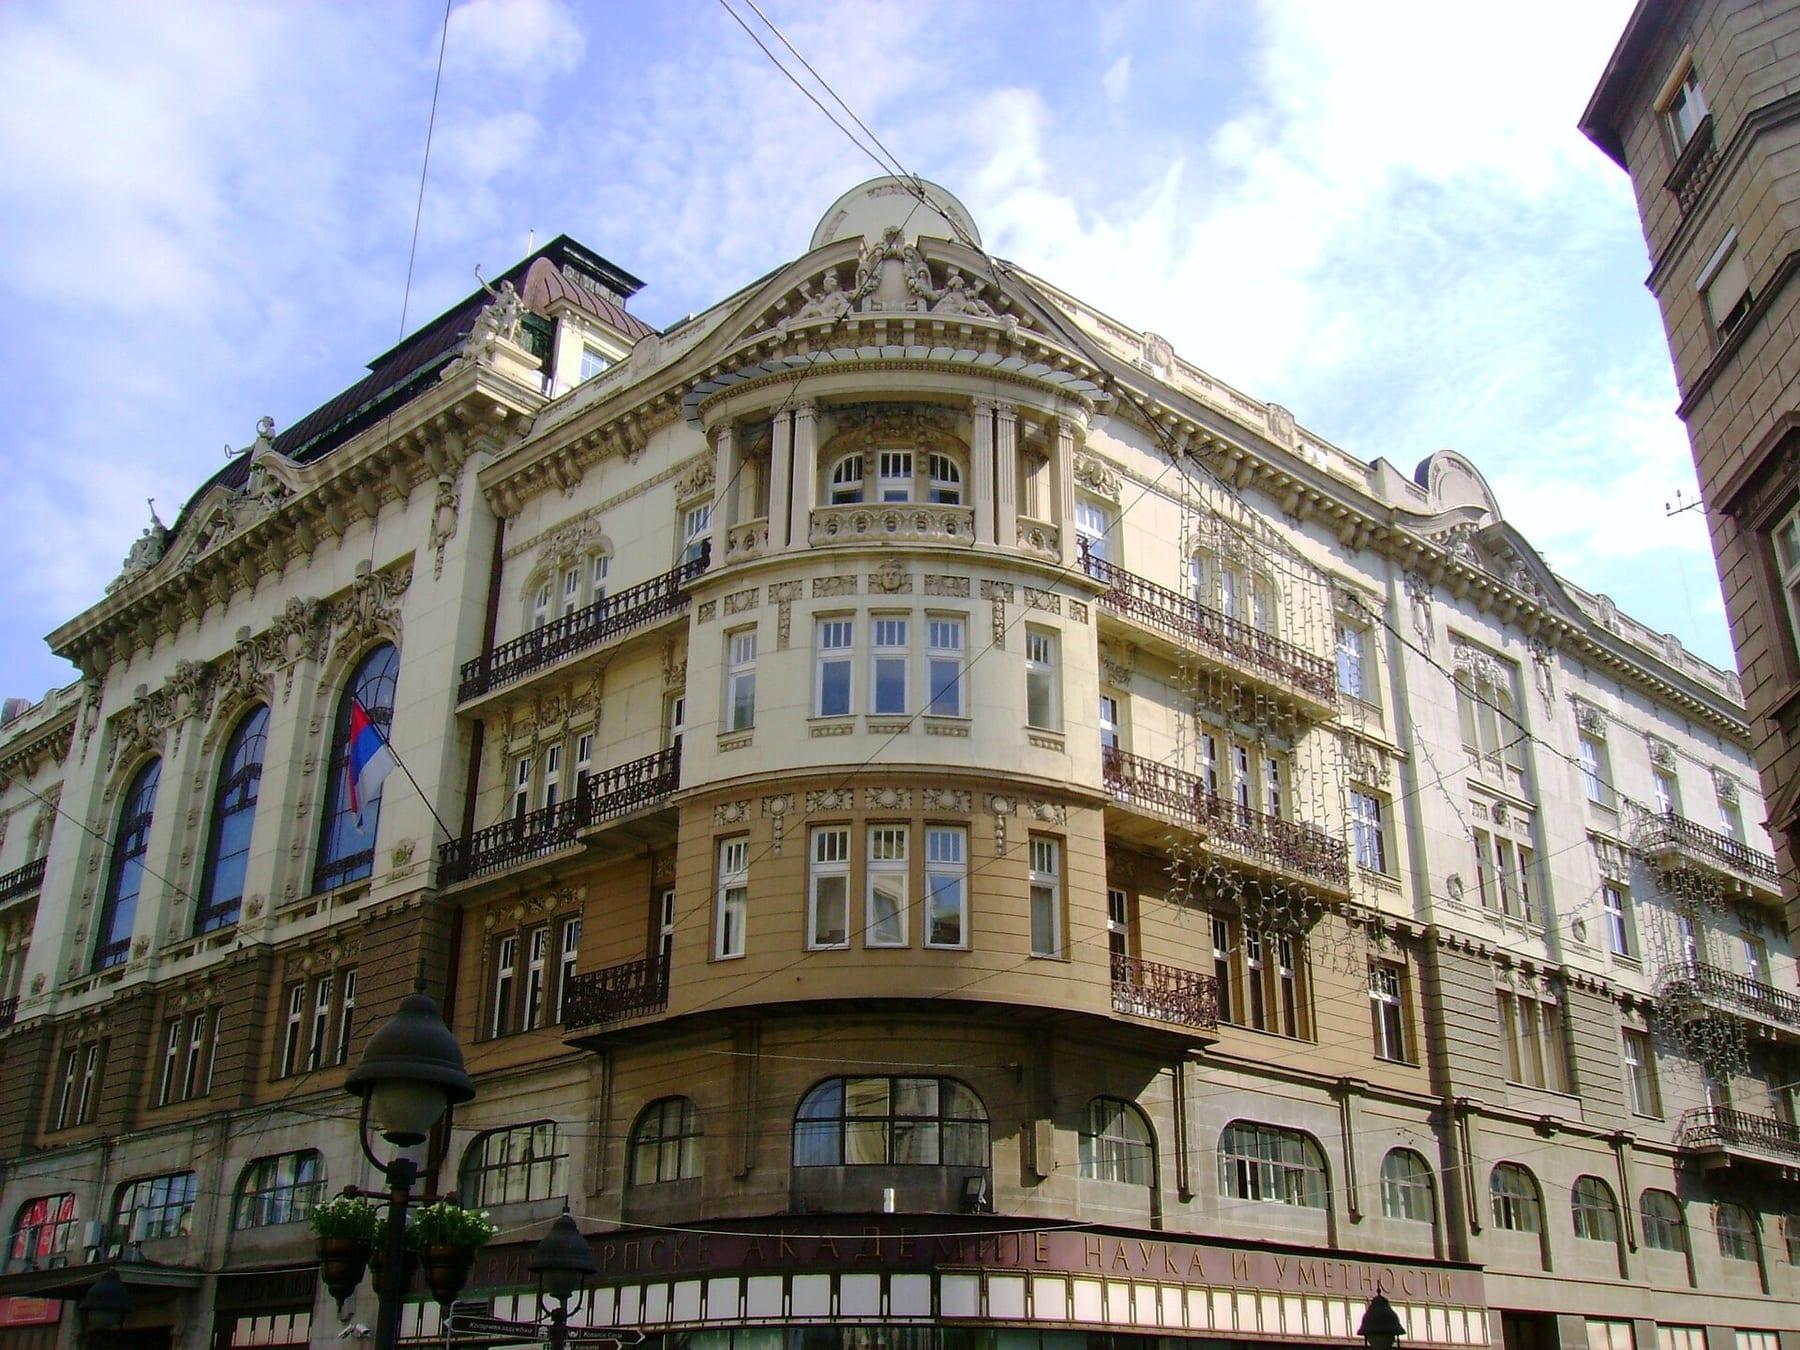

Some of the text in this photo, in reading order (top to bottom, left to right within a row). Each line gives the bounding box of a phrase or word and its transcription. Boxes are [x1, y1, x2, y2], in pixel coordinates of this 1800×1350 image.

[601, 1234, 712, 1273] РПСКЕ
[745, 1226, 1050, 1264] АКАДЕМИЈЕ
[1084, 1235, 1206, 1279] НАУКА
[1231, 1252, 1249, 1281] И
[1273, 1256, 1453, 1299] УМЕТНОСТИ
